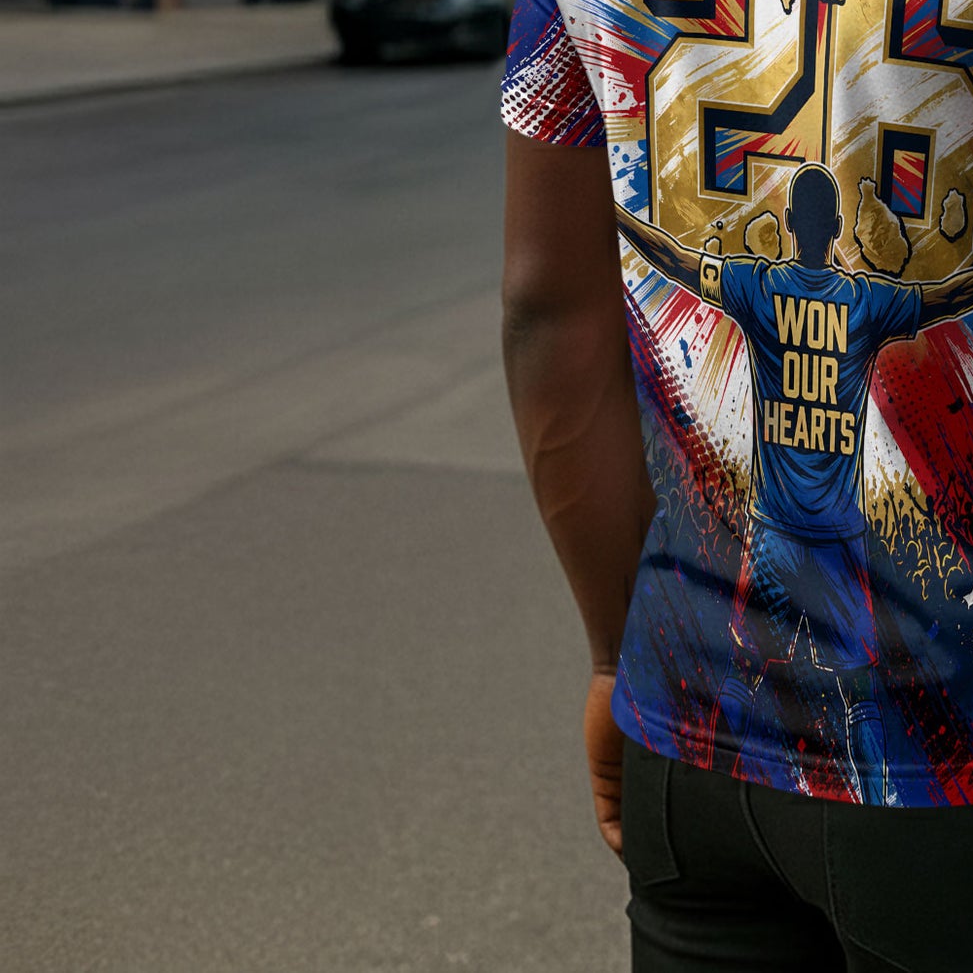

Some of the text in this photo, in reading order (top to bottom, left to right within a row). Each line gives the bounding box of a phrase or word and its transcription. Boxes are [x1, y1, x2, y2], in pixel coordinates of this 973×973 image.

[703, 263, 719, 282] C
[773, 294, 848, 353] WON
[783, 350, 838, 405] OUR
[764, 400, 855, 455] HEARTS
